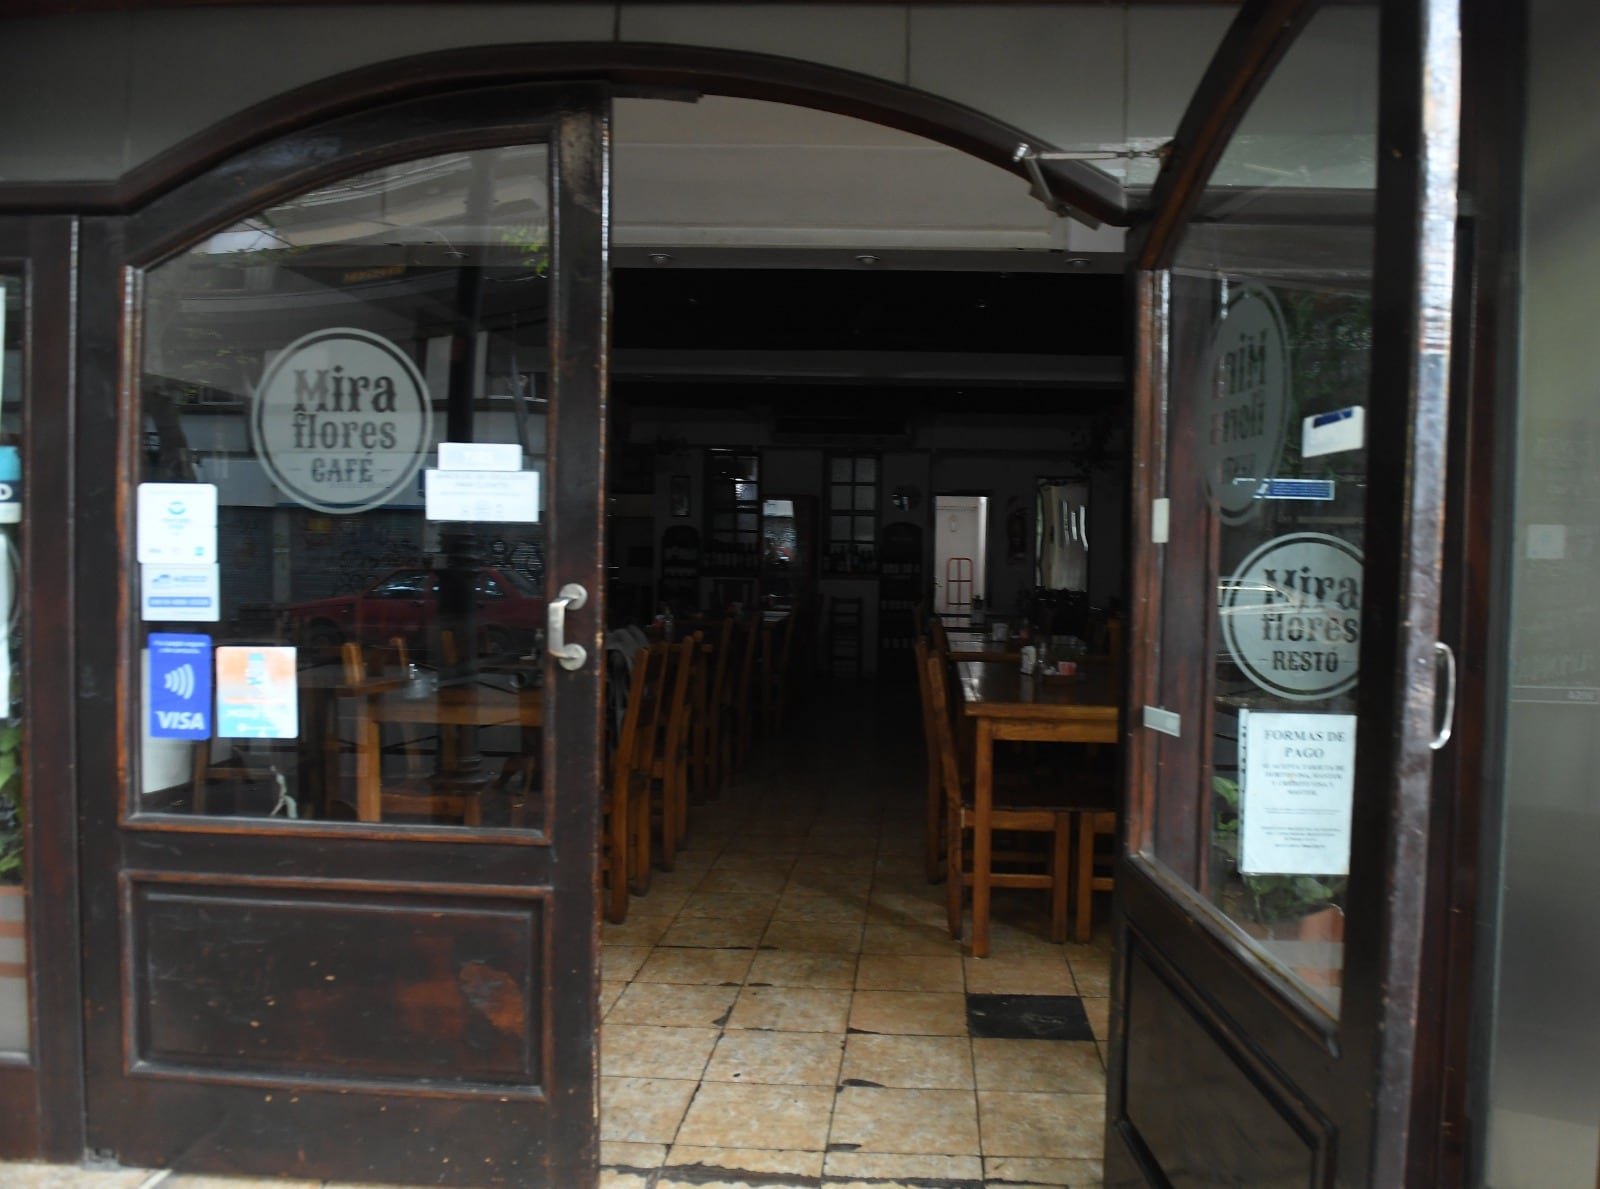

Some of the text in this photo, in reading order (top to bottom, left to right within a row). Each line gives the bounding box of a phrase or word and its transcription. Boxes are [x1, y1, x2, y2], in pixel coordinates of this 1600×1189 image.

[294, 365, 396, 412] Mira
[292, 412, 397, 449] flores
[311, 452, 374, 482] CAFÉ
[1264, 566, 1360, 610] Mira
[1262, 612, 1359, 643] flores
[155, 711, 205, 730] VISA
[1264, 729, 1345, 742] FORMAS DE
[1284, 747, 1325, 758] PAGO
